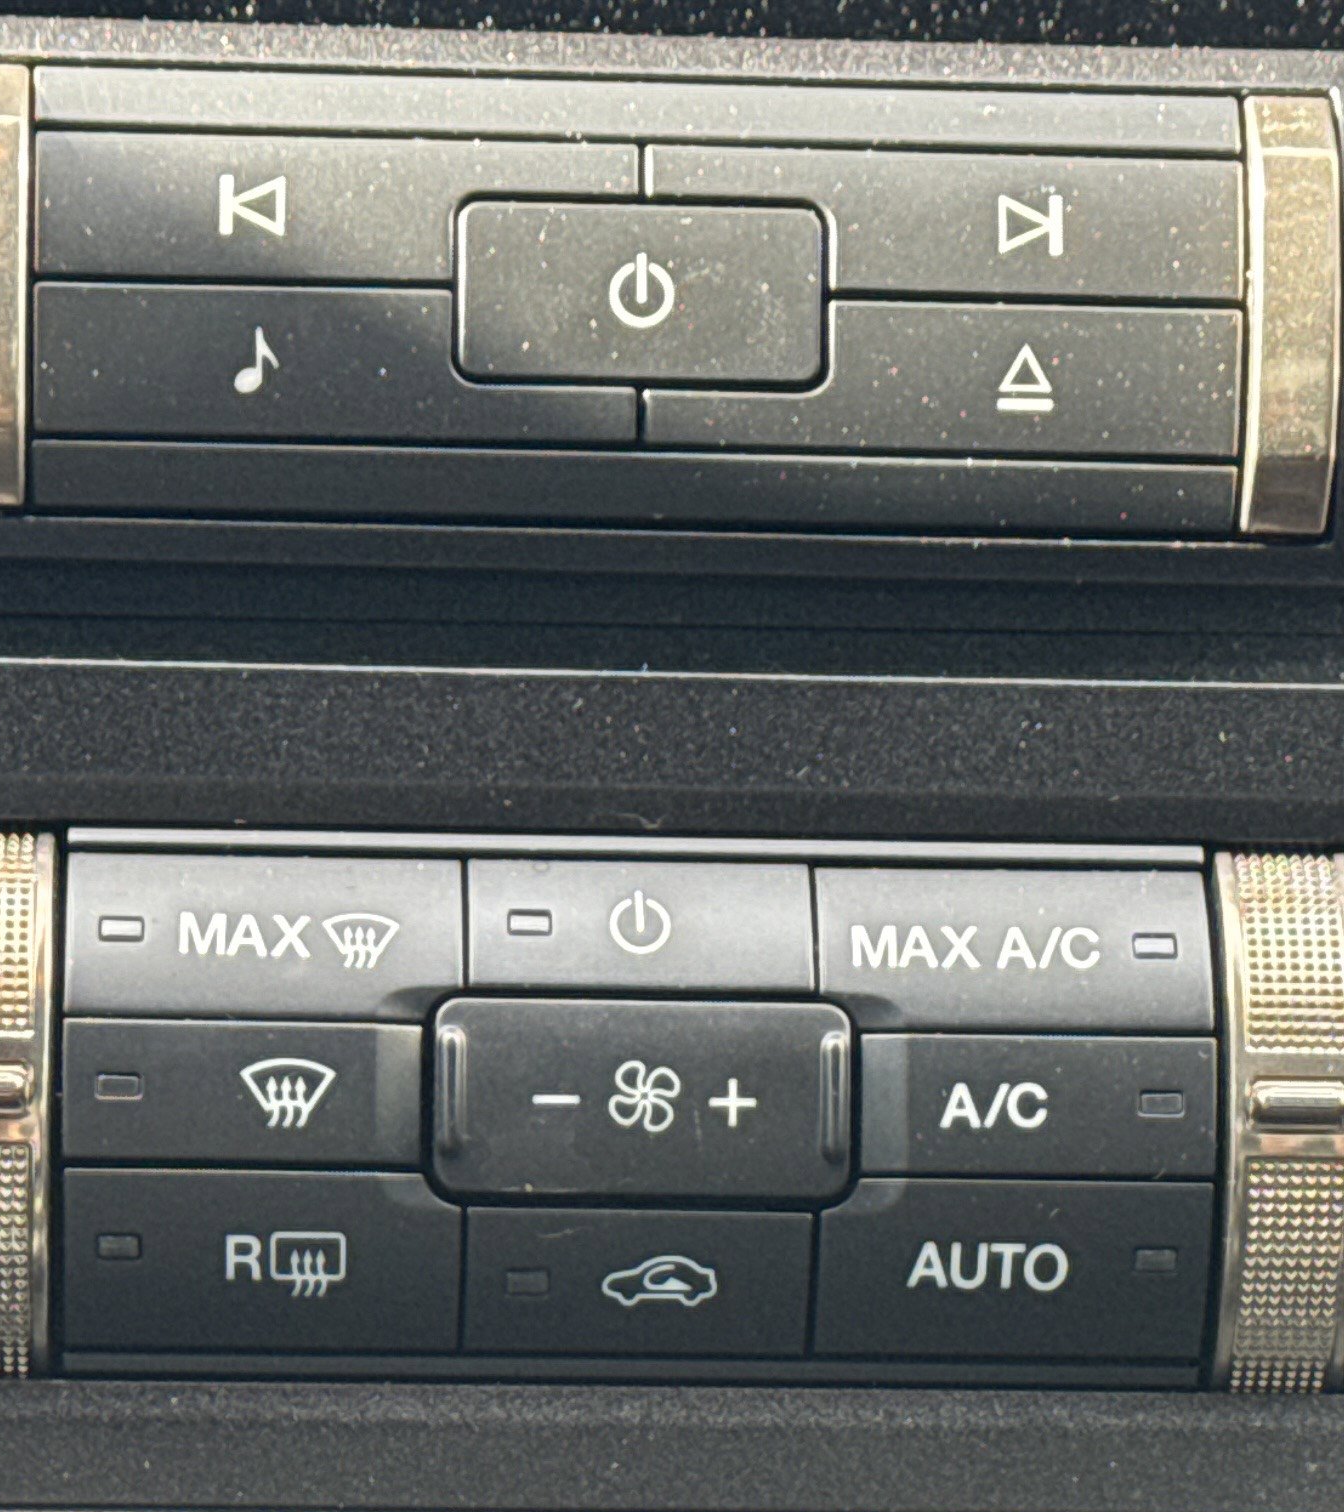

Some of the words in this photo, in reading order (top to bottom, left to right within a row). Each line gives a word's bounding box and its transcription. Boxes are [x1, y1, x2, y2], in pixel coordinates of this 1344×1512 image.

[177, 911, 312, 958] MAX
[850, 925, 981, 969] MAX
[996, 926, 1101, 970] A/C
[940, 1082, 1048, 1129] A/C
[224, 1233, 262, 1281] R
[907, 1241, 1069, 1291] AUTO
